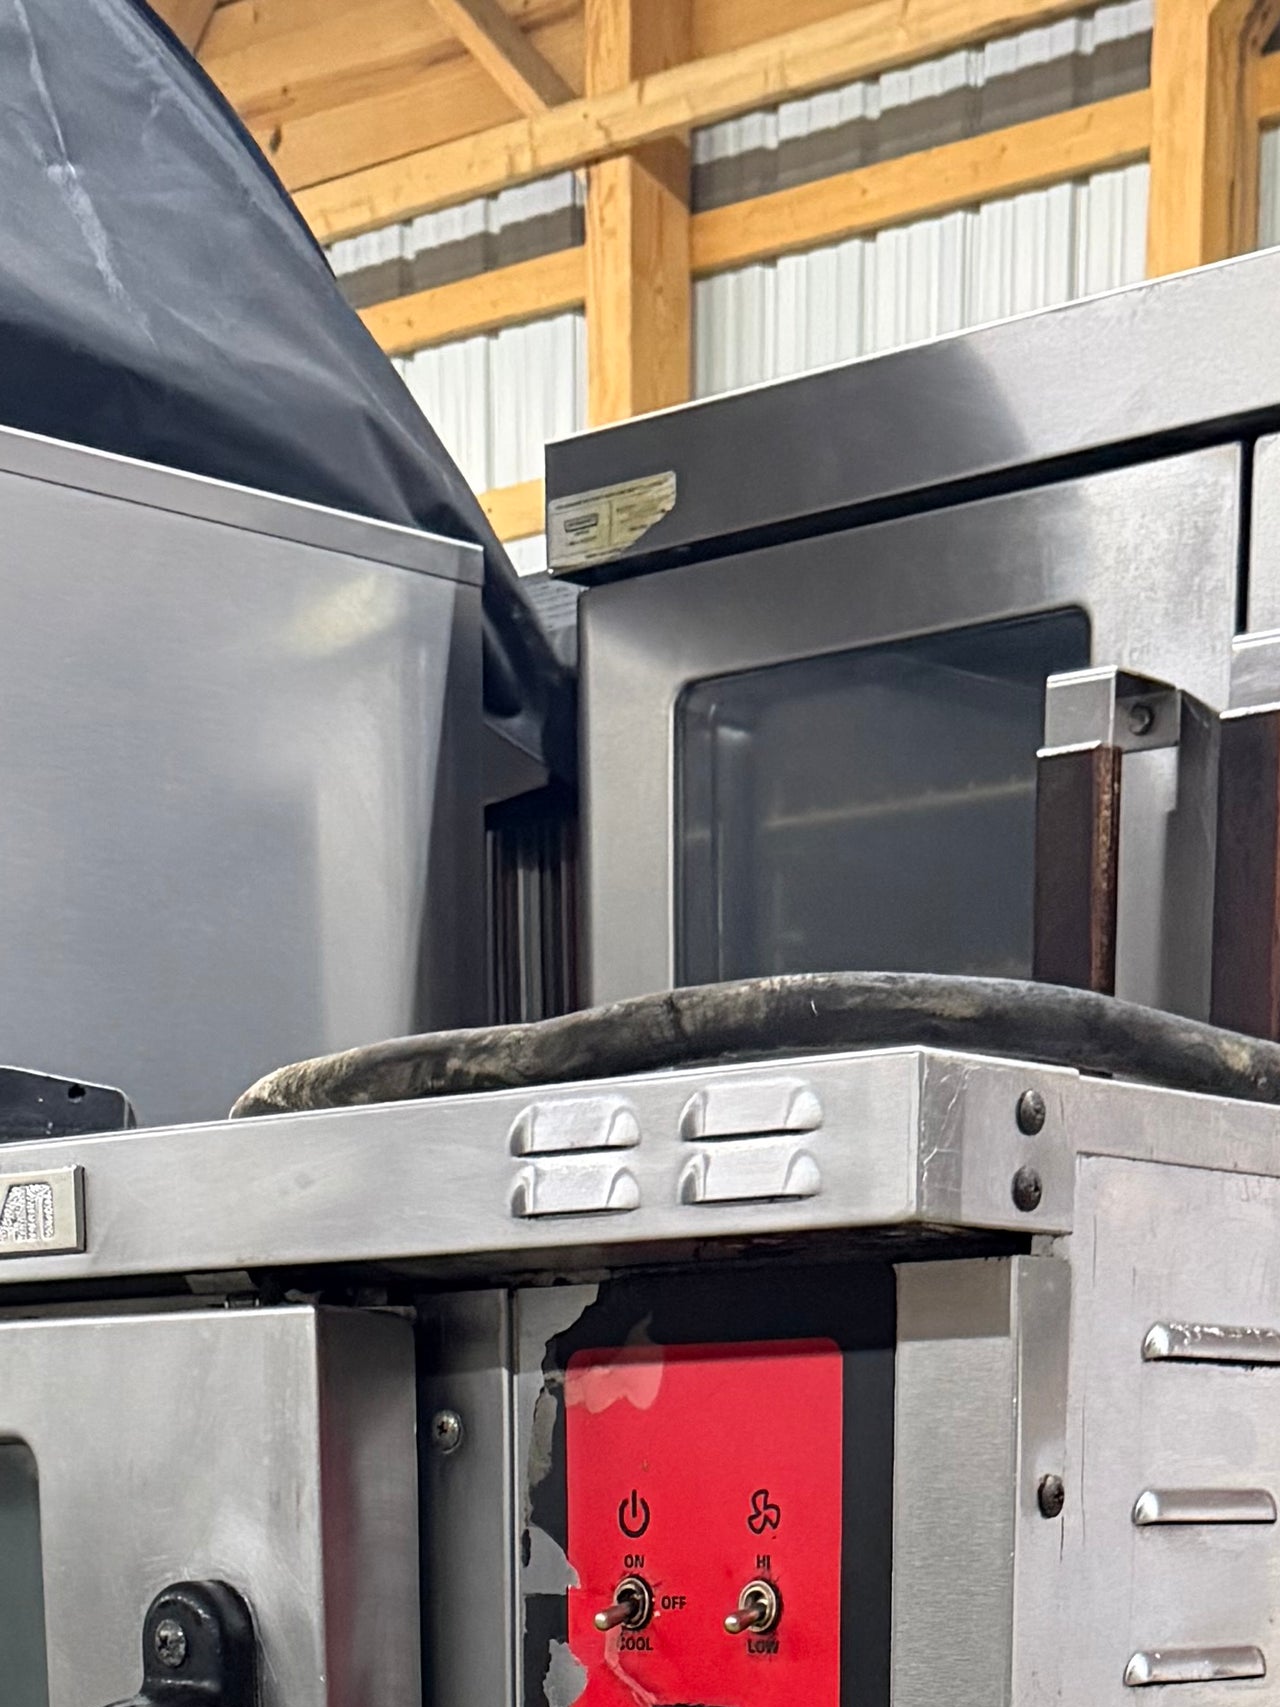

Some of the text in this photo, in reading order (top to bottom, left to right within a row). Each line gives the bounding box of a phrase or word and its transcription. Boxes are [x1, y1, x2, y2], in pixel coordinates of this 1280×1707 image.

[624, 1554, 644, 1569] ON
[757, 1555, 771, 1570] HI
[661, 1596, 687, 1610] OFF
[747, 1639, 779, 1655] LOW
